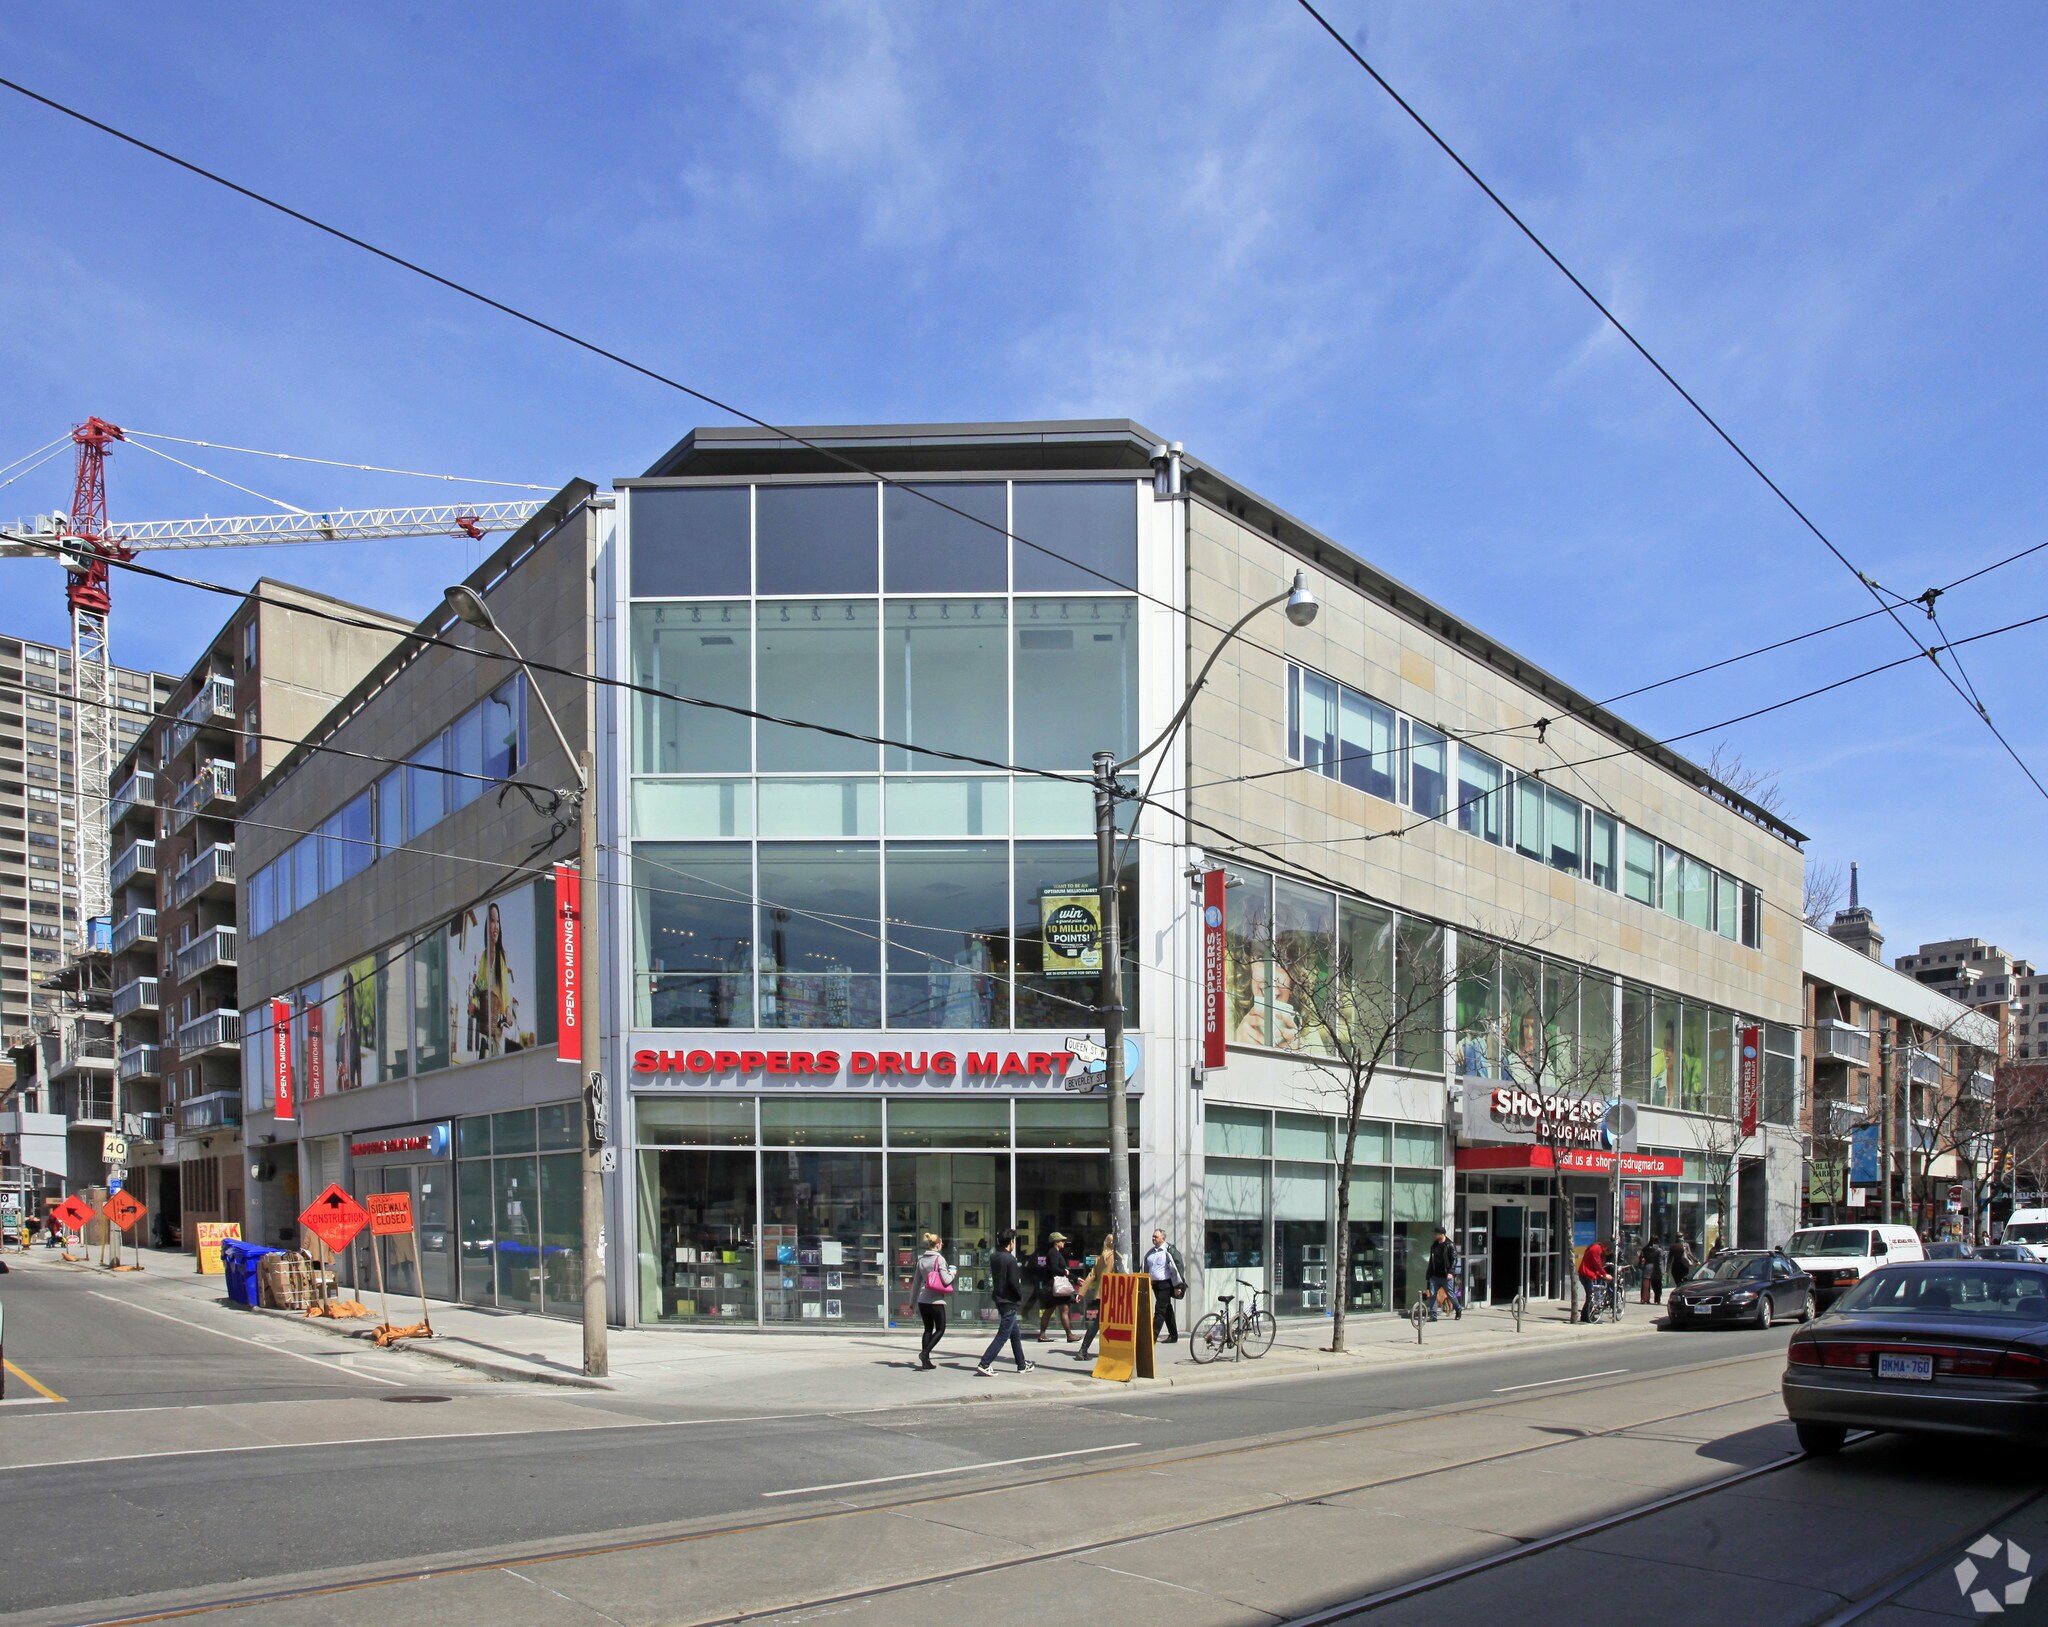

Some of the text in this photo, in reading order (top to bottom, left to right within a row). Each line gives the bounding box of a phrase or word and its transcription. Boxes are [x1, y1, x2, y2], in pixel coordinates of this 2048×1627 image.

[1059, 907, 1083, 919] win
[1047, 924, 1097, 933] 10 MILLION
[1053, 933, 1090, 943] POINTS!
[563, 901, 575, 1027] OPEN TO MIDNIGHT
[1207, 932, 1216, 1033] SHOPPERS
[1068, 1040, 1105, 1058] QUEEN ST W
[279, 1061, 287, 1077] TO
[632, 1049, 1076, 1075] SHOPPERS DRUG MART
[1068, 1075, 1094, 1088] BEVERLEY
[280, 1081, 288, 1099] OPEN
[1494, 1088, 1604, 1123] SHOPPERS
[1574, 1126, 1603, 1142] MART
[106, 1142, 125, 1154] 40
[1557, 1150, 1665, 1173] Visit us at shoprsdrugmart.ca
[1815, 1162, 1837, 1170] BLAK
[370, 1201, 409, 1214] SIDEWALK
[307, 1212, 364, 1225] CONSTRUCTION
[376, 1213, 407, 1226] CLOSED
[198, 1223, 240, 1239] BARK
[1101, 1275, 1136, 1325] PARK
[1881, 1359, 1930, 1374] BKMA 760
